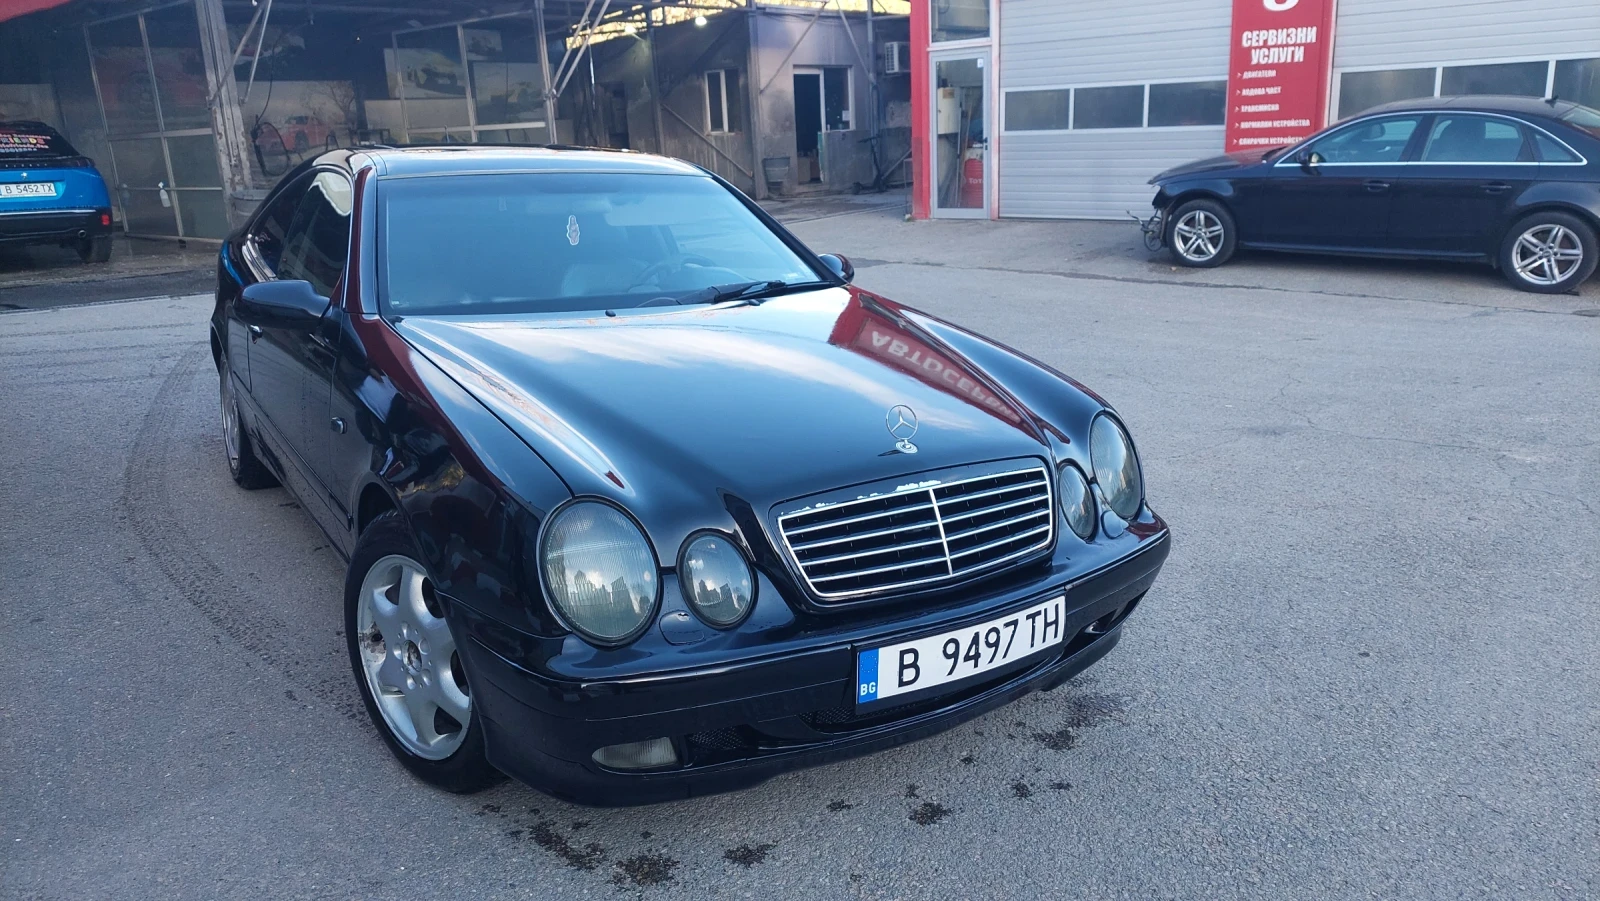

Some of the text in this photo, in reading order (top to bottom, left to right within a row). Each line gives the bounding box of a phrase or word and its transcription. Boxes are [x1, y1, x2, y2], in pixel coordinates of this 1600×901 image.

[1241, 26, 1317, 47] СЕРВИЗНИ
[1250, 46, 1305, 65] УСЛУГИ
[16, 185, 40, 194] 5452
[41, 184, 54, 193] TX
[897, 603, 1060, 688] B 9497 TH
[860, 682, 877, 696] BG
